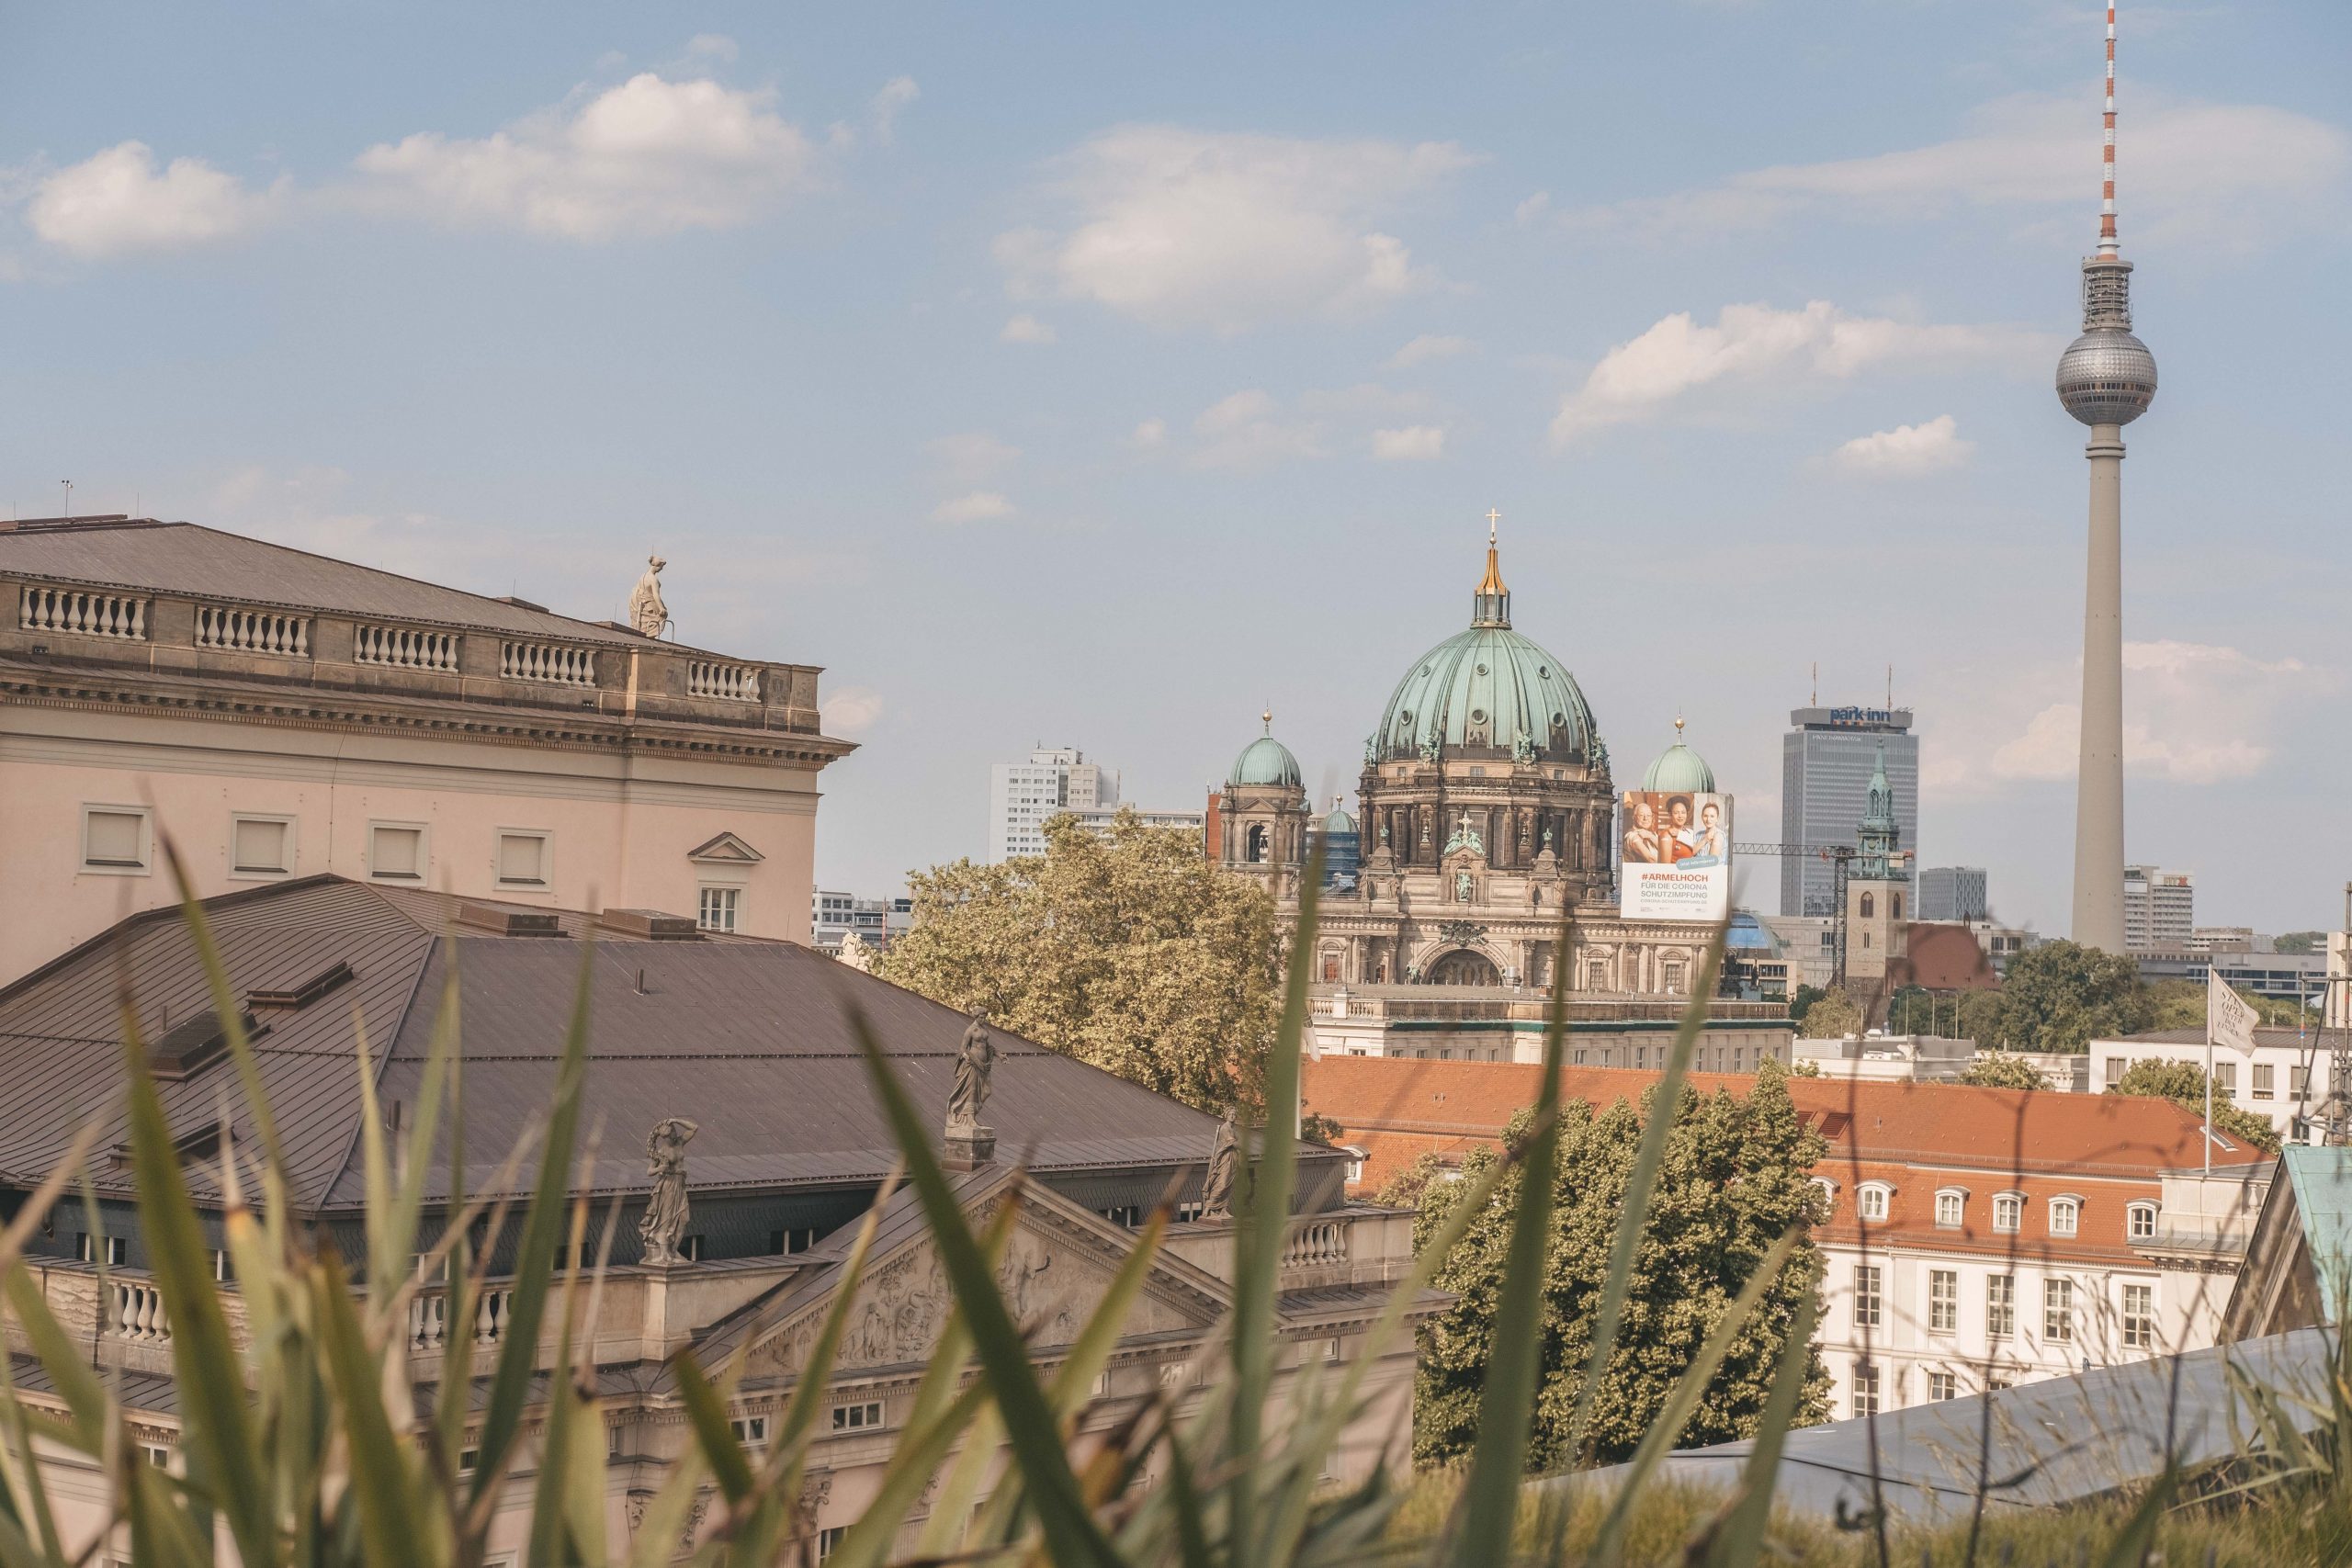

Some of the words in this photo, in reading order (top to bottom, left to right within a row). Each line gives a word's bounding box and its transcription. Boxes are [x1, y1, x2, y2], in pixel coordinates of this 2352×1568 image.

[1830, 706, 1863, 725] park
[1867, 707, 1890, 721] inn
[1642, 873, 1708, 882] #ÄRMELHOCH
[1641, 881, 1656, 889] FÜR
[1641, 890, 1708, 898] SCHUTZIMPFUNG
